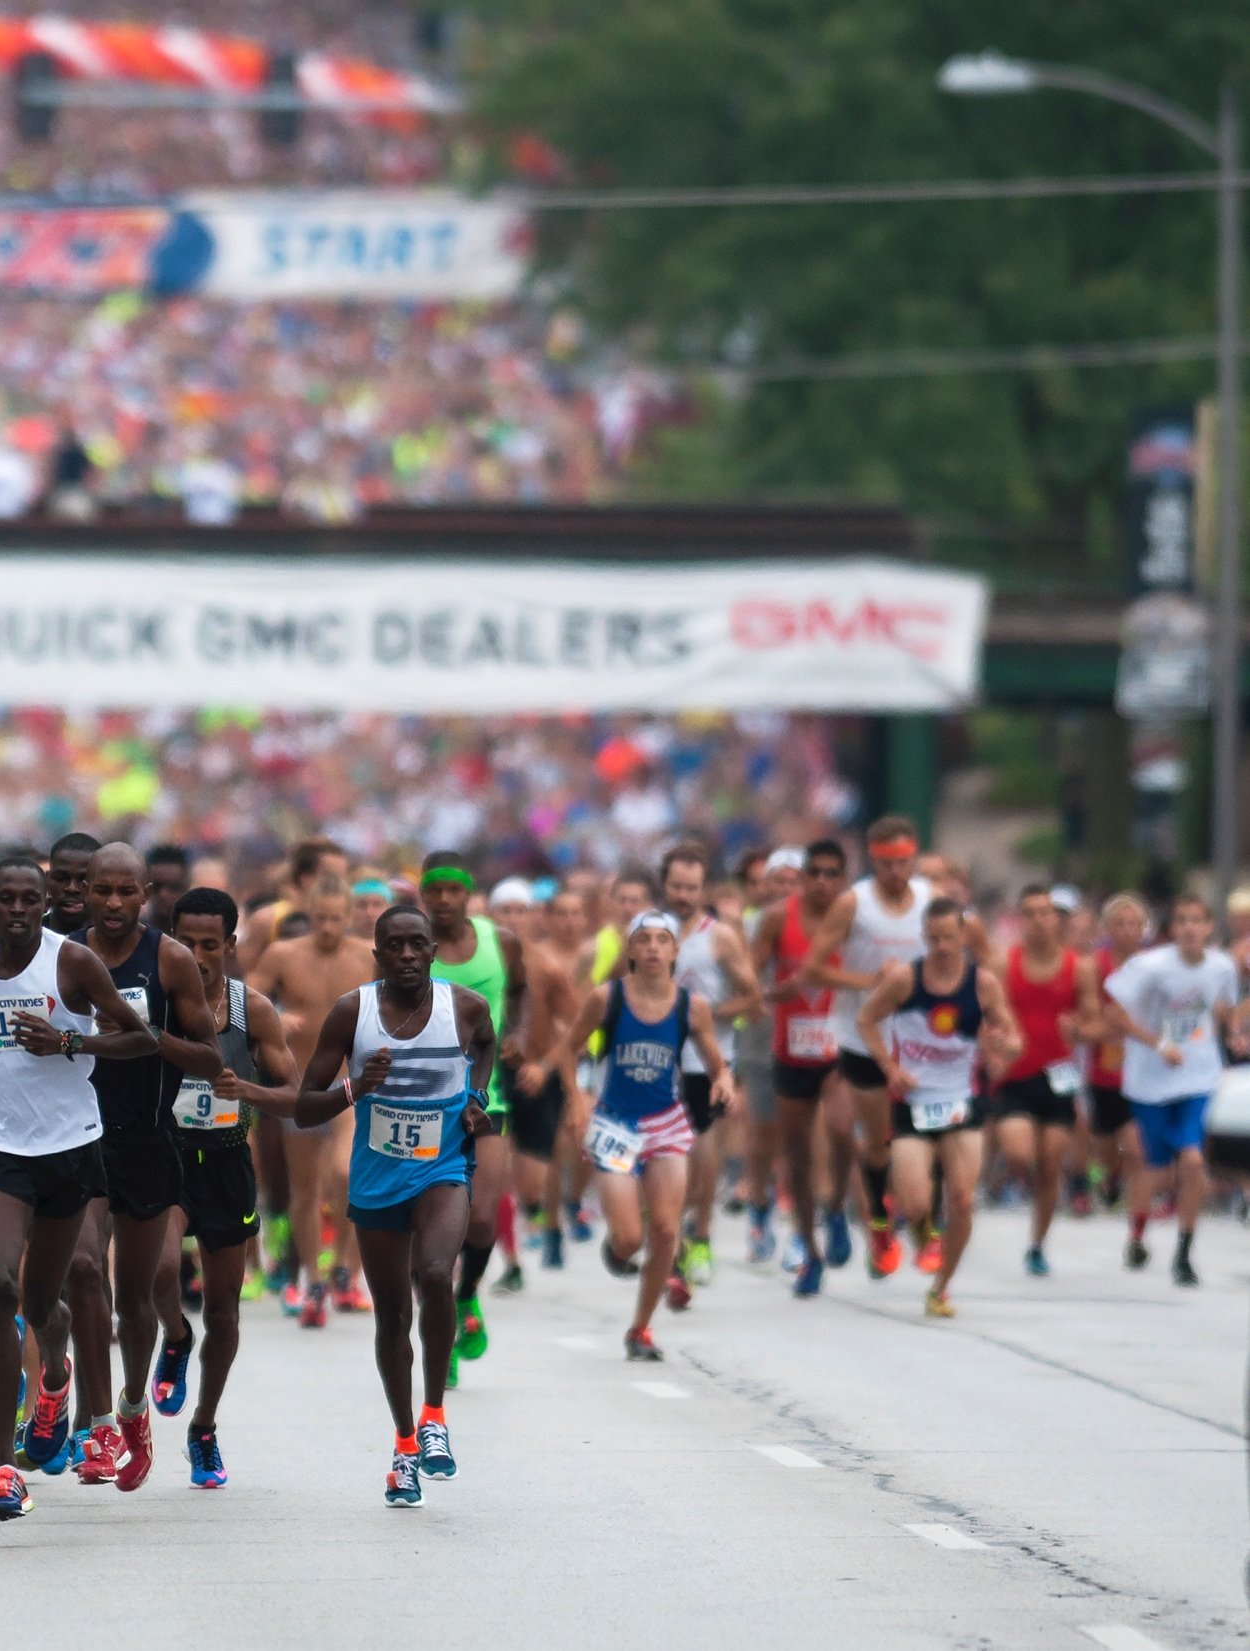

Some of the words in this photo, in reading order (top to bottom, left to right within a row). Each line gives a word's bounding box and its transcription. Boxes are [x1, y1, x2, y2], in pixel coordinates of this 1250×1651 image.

[261, 220, 458, 274] START
[194, 603, 344, 668] GMC
[372, 606, 693, 670] DEALERS
[728, 599, 946, 662] GMC
[0, 999, 17, 1008] CITY
[18, 998, 44, 1008] TIMES
[616, 1042, 673, 1069] LAKEVIEW
[196, 1094, 212, 1117] 9
[374, 1106, 396, 1119] QUAD
[396, 1112, 415, 1121] CITY
[416, 1111, 440, 1123] TIMES
[389, 1122, 422, 1148] 15
